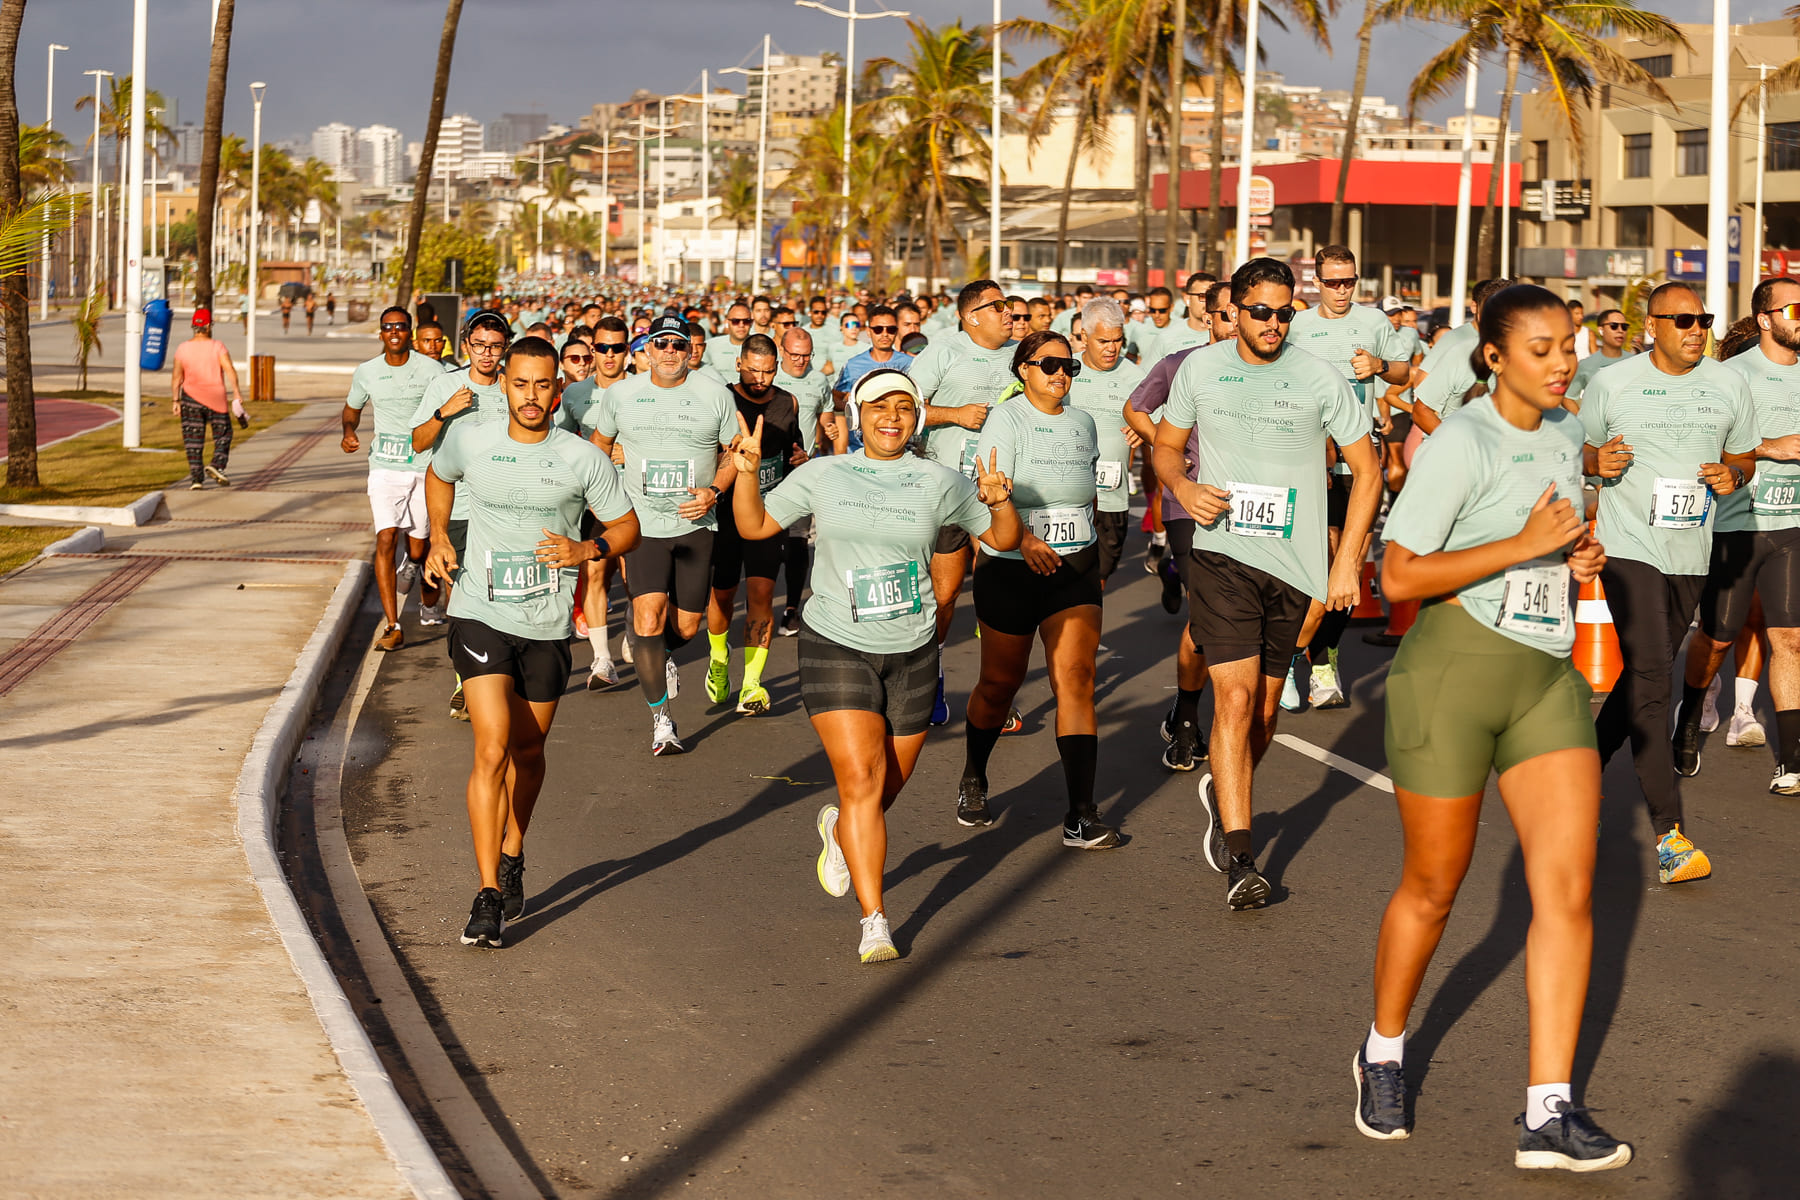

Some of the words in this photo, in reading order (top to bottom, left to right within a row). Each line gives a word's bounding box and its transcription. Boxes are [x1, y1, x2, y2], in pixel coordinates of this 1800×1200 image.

[1218, 375, 1244, 383] CAIXA
[1642, 388, 1667, 396] CAIXA
[1212, 407, 1247, 421] circuito
[1034, 426, 1054, 434] CAIXA
[1640, 420, 1673, 430] circuito
[491, 455, 517, 464] CAIXA
[760, 466, 776, 484] 936
[852, 465, 877, 475] CAIXA
[651, 471, 684, 489] 4479
[1671, 493, 1696, 516] 572
[1764, 486, 1796, 505] 4939
[838, 499, 870, 510] circuito
[880, 505, 917, 517] estações
[1240, 499, 1276, 525] 1845
[1285, 501, 1294, 526] VERDE
[895, 513, 917, 524] caixa
[1043, 521, 1076, 542] 2750
[502, 563, 541, 590] 4481
[867, 579, 903, 607] 4195
[1523, 581, 1550, 615] 546
